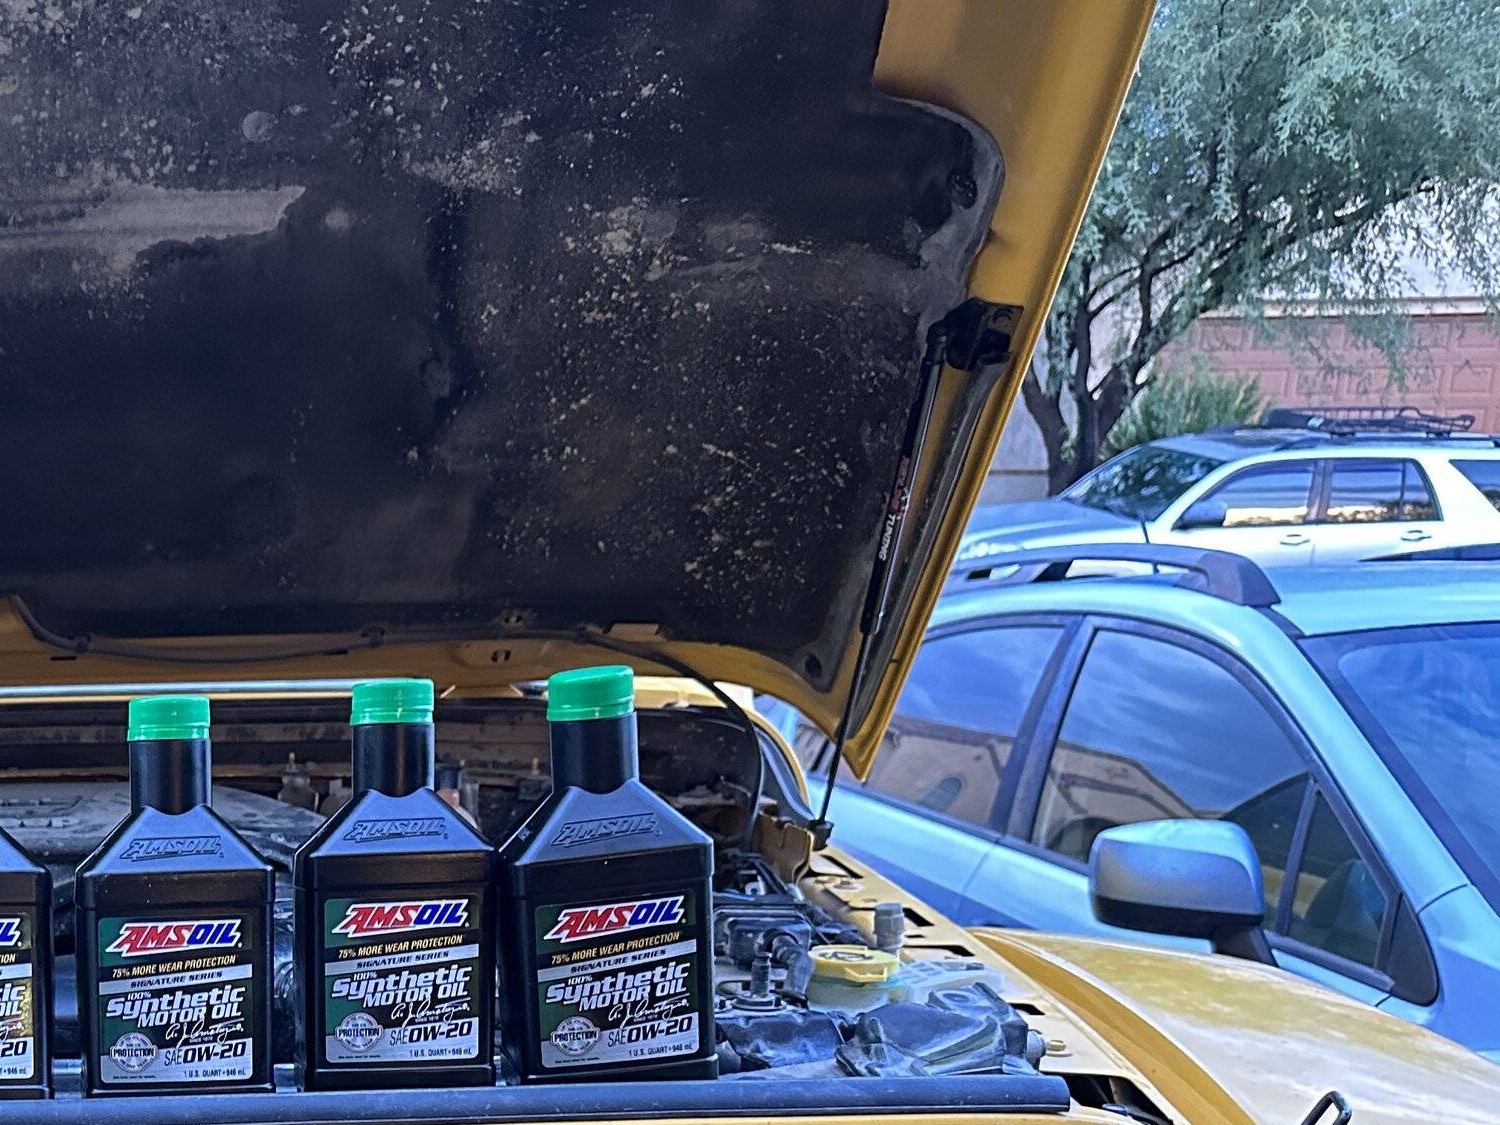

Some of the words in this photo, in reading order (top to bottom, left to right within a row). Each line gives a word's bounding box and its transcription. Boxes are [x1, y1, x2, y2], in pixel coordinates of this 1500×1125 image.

[343, 817, 445, 843] AMSOIL
[550, 812, 657, 848] AMSOIL
[119, 836, 222, 862] AMSOIL
[332, 899, 468, 937] AMSOIL
[544, 895, 684, 943] AMSOIL
[105, 919, 241, 957] AMSOIL
[339, 949, 356, 958] 75%
[358, 946, 382, 956] MORE
[385, 942, 409, 953] WEAR
[411, 935, 462, 950] PROTECTION
[552, 954, 570, 965] 75%
[572, 948, 597, 960] MORE
[599, 944, 624, 955] WEAR
[626, 932, 680, 950] PROTECTION
[112, 969, 130, 978] 75%
[132, 965, 156, 975] MORE
[159, 961, 182, 972] WEAR
[185, 955, 236, 969] PROTECTION
[357, 956, 412, 968] SIGNATURE
[415, 952, 449, 961] SERIES
[571, 957, 628, 973] SIGNATURE
[631, 950, 666, 962] SERIES
[131, 976, 186, 988] SIGNATURE
[189, 972, 222, 981] SERIES
[332, 964, 472, 1000] Synthetic
[353, 972, 377, 980] 100%
[546, 962, 690, 1005] Synthetic
[568, 976, 592, 985] 100%
[106, 985, 245, 1020] Synthetic
[128, 991, 151, 1000] 100%
[363, 987, 432, 1008] MOTOR
[438, 981, 468, 999] OIL
[579, 987, 649, 1011] MOTOR
[656, 981, 686, 997] OIL
[138, 1007, 206, 1027] MOTOR
[212, 1002, 241, 1020] OIL
[339, 1029, 379, 1037] PROTECTION
[390, 1030, 407, 1046] SAE
[408, 1021, 472, 1043] 0W-20
[555, 1030, 597, 1042] PROTECTION
[608, 1032, 626, 1047] SAE
[627, 1016, 692, 1043] 0W-20
[114, 1048, 153, 1057] PROTECTION
[165, 1050, 182, 1066] SAE
[183, 1042, 246, 1063] 0W-20
[648, 1046, 667, 1054] QUART
